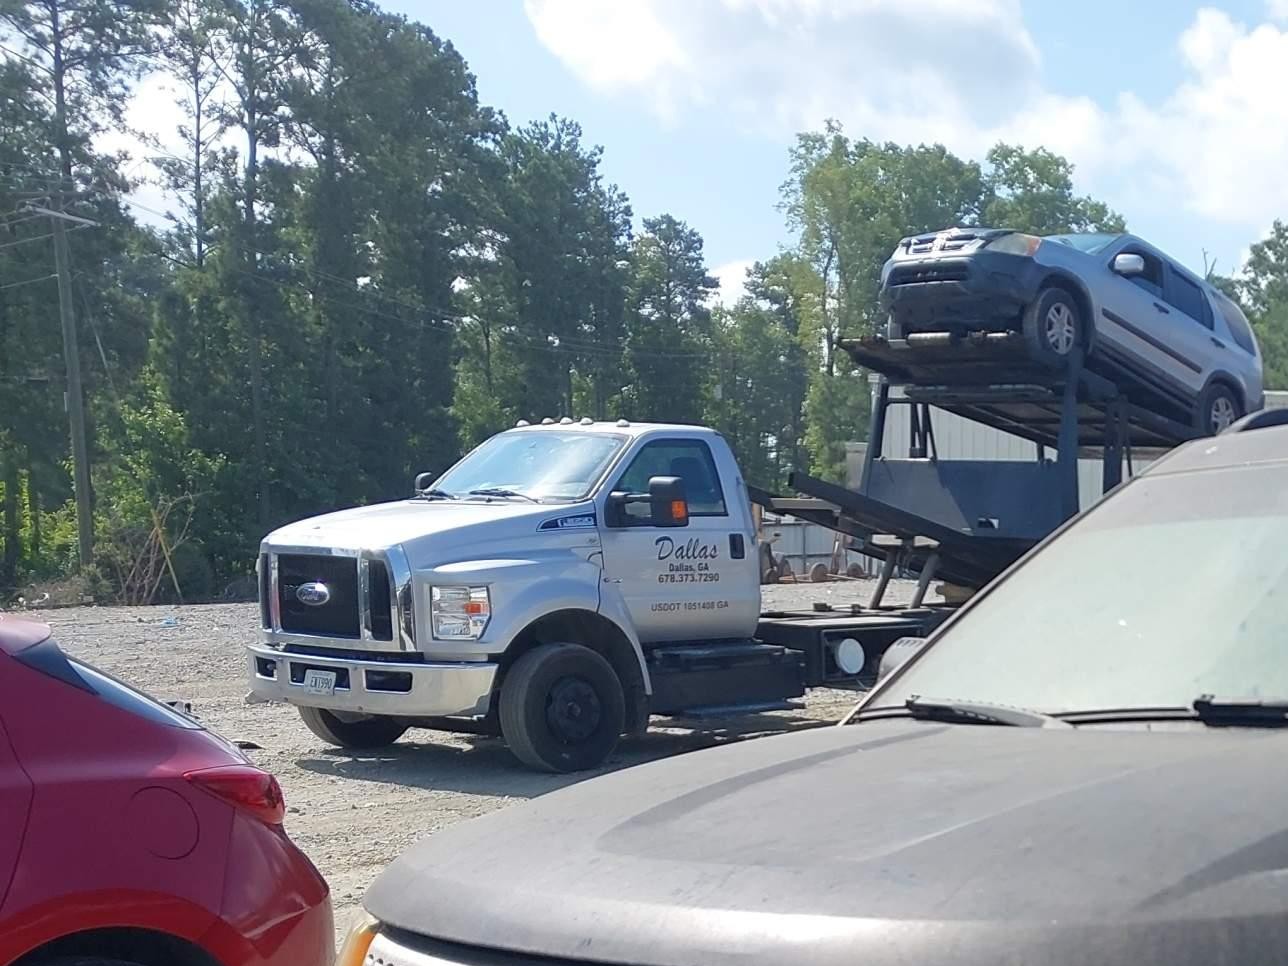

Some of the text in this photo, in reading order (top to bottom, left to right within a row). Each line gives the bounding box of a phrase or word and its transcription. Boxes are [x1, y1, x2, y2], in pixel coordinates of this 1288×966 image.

[655, 536, 719, 560] Dallas
[697, 562, 709, 571] GA
[658, 573, 720, 583] 678.373.7290
[651, 602, 681, 612] USDOT
[716, 600, 729, 609] GA
